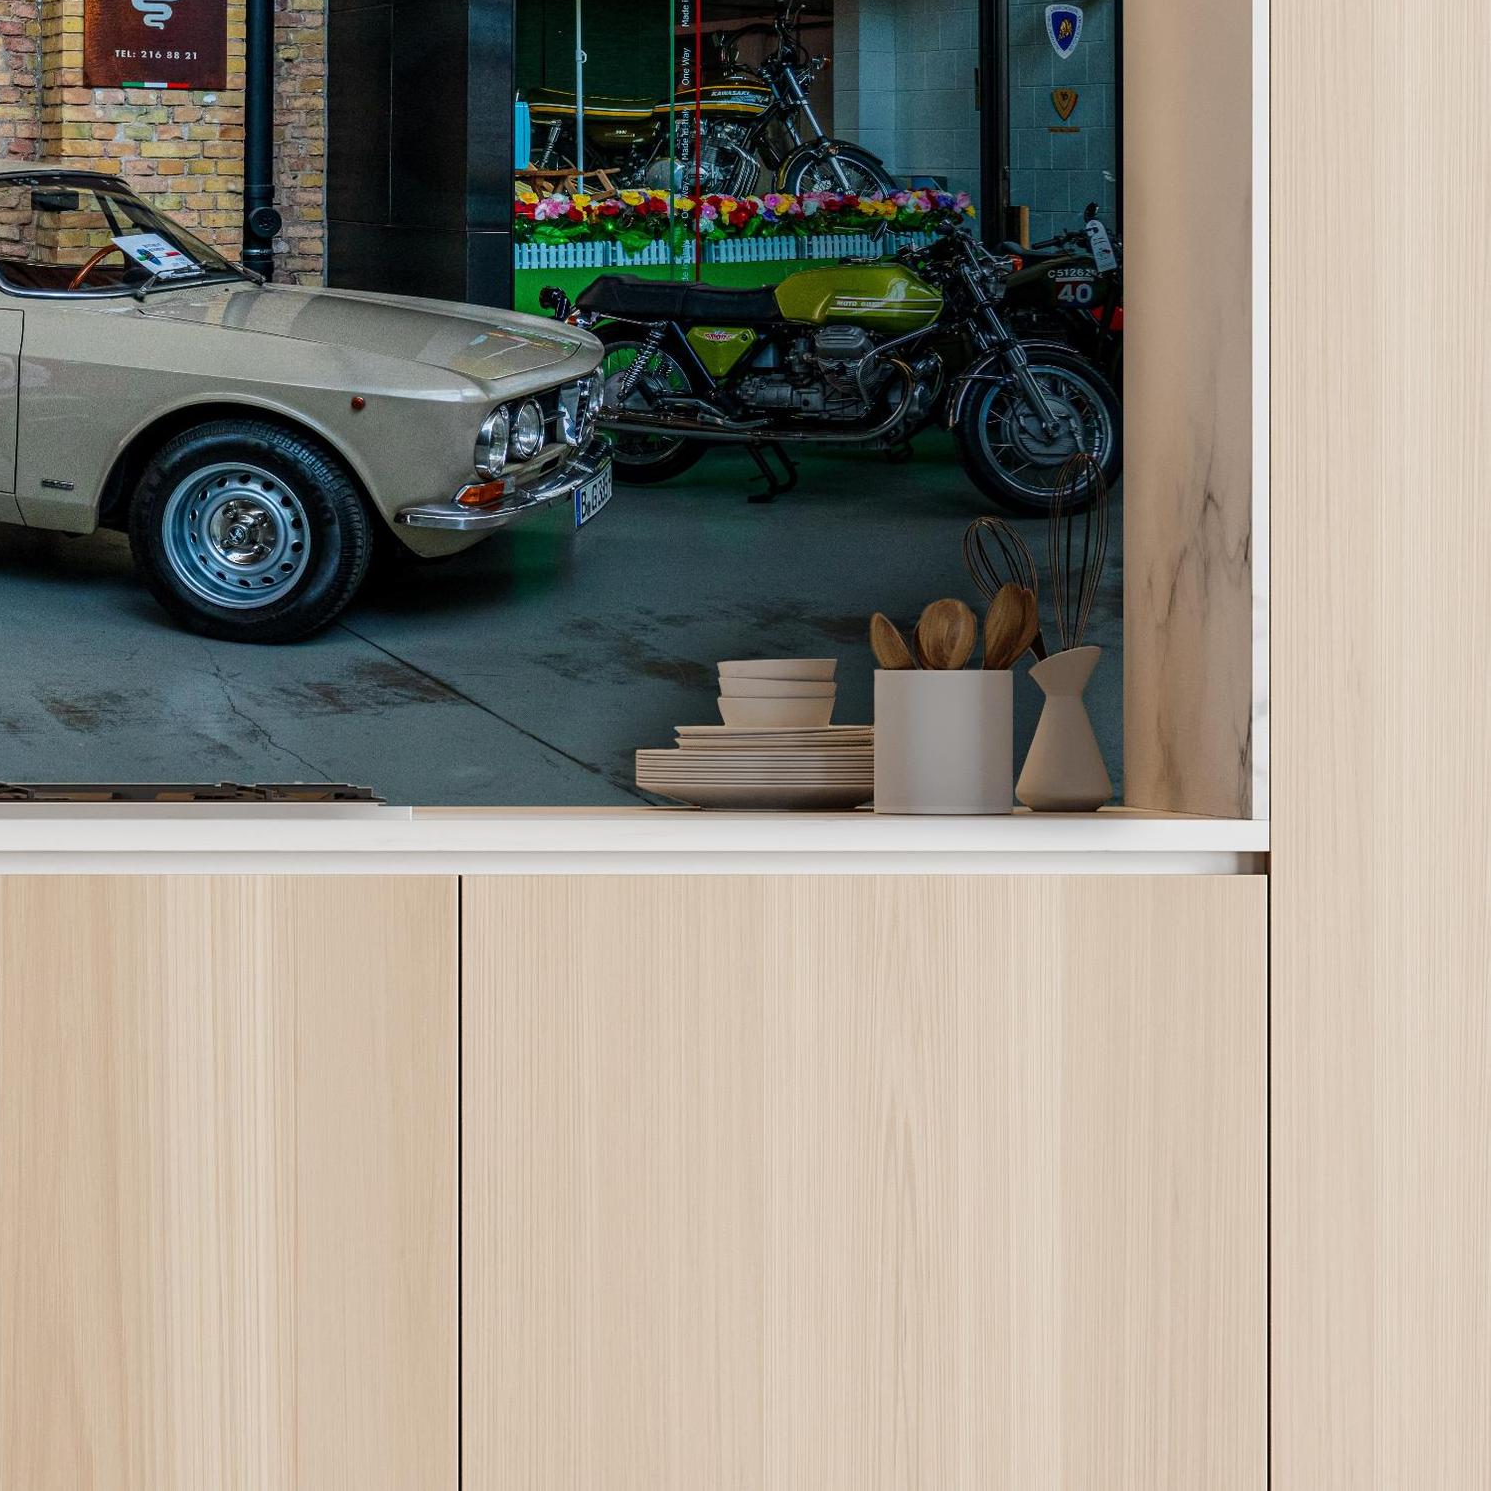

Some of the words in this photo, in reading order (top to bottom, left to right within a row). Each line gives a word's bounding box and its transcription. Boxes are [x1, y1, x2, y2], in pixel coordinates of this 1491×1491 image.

[682, 4, 690, 28] Made
[115, 50, 136, 58] TEL:
[141, 50, 162, 59] 216
[166, 51, 180, 59] 88
[184, 51, 197, 60] 21
[682, 48, 691, 66] Way
[682, 68, 690, 86] One
[682, 139, 690, 161] Made
[1057, 283, 1093, 303] 40
